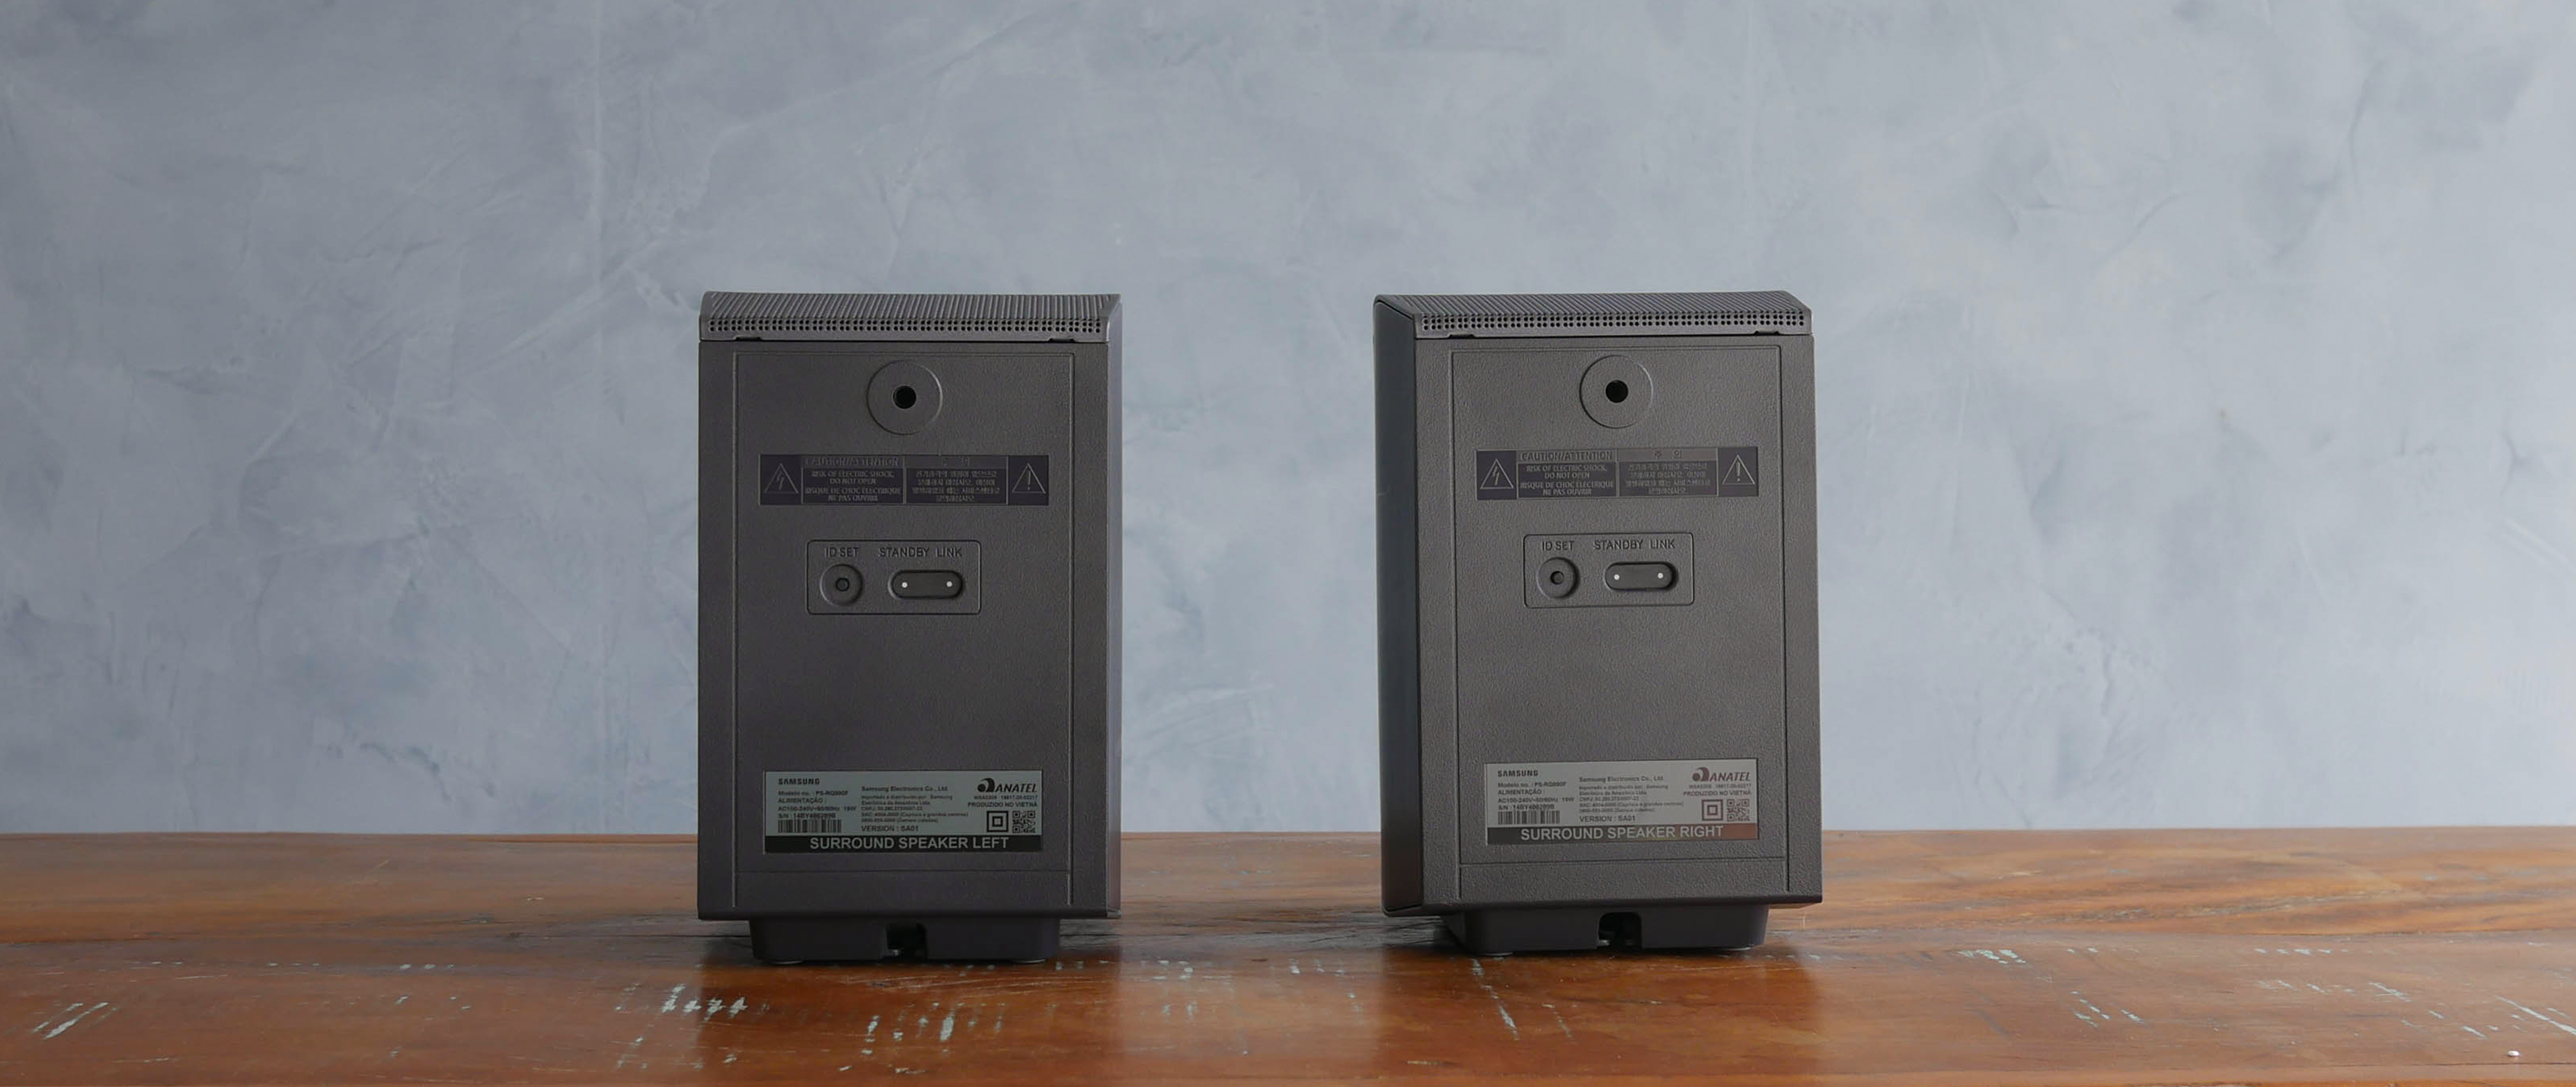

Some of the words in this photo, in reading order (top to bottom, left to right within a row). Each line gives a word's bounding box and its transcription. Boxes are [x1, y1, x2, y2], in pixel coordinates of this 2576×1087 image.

[1520, 451, 1613, 462] CAUTION/ATTENTION
[1542, 541, 1553, 550] ID
[1555, 541, 1574, 550] SET
[1594, 539, 1644, 550] STANDBY
[1649, 539, 1676, 549] LINK
[825, 547, 837, 557] ID
[839, 547, 859, 557] SET
[878, 547, 930, 557] STANDBY
[935, 547, 963, 557] LINK
[1709, 772, 1751, 782] ANATEL
[994, 783, 1038, 792] ANATEL
[1521, 828, 1603, 841] SURROUND
[1607, 827, 1676, 839] SPEAKER
[1680, 825, 1723, 837] RIGHT
[810, 837, 895, 849] SURROUND
[898, 837, 969, 849] SPEAKER
[973, 837, 1009, 848] LEFT
